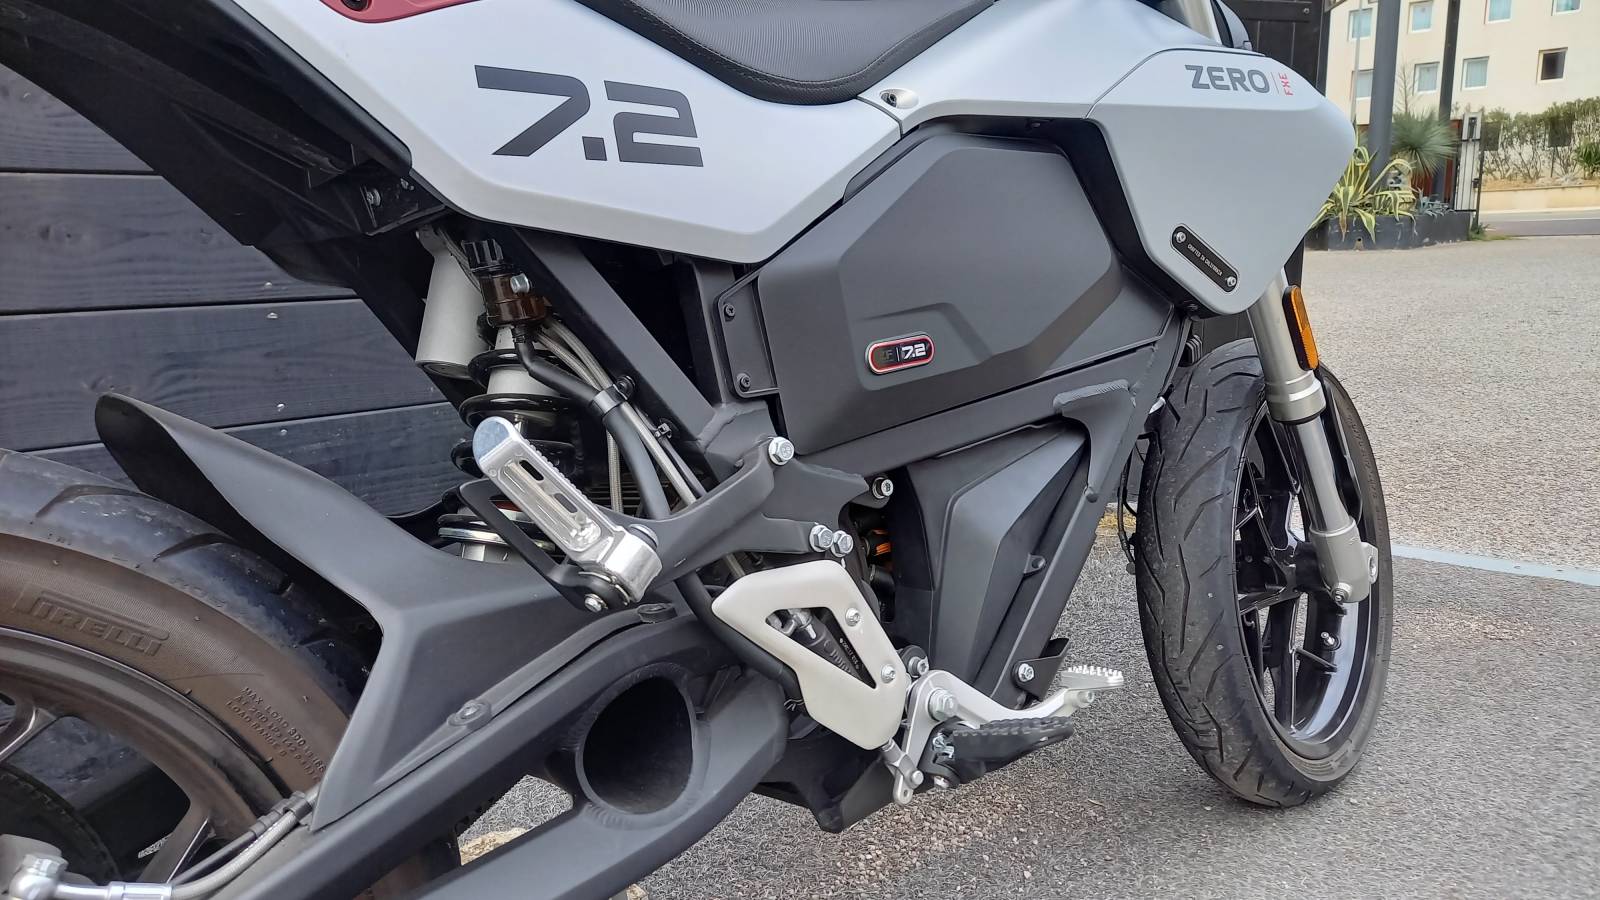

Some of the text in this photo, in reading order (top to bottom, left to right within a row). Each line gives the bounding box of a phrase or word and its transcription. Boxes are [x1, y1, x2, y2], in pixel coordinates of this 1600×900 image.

[1184, 64, 1270, 94] ZERO
[1279, 73, 1295, 96] FXE
[474, 64, 704, 168] 7.2
[901, 343, 927, 360] 7.2
[12, 583, 170, 657] PIRELLI
[225, 700, 252, 723] LOAD
[240, 686, 263, 704] MAX
[264, 704, 289, 729] LOAD
